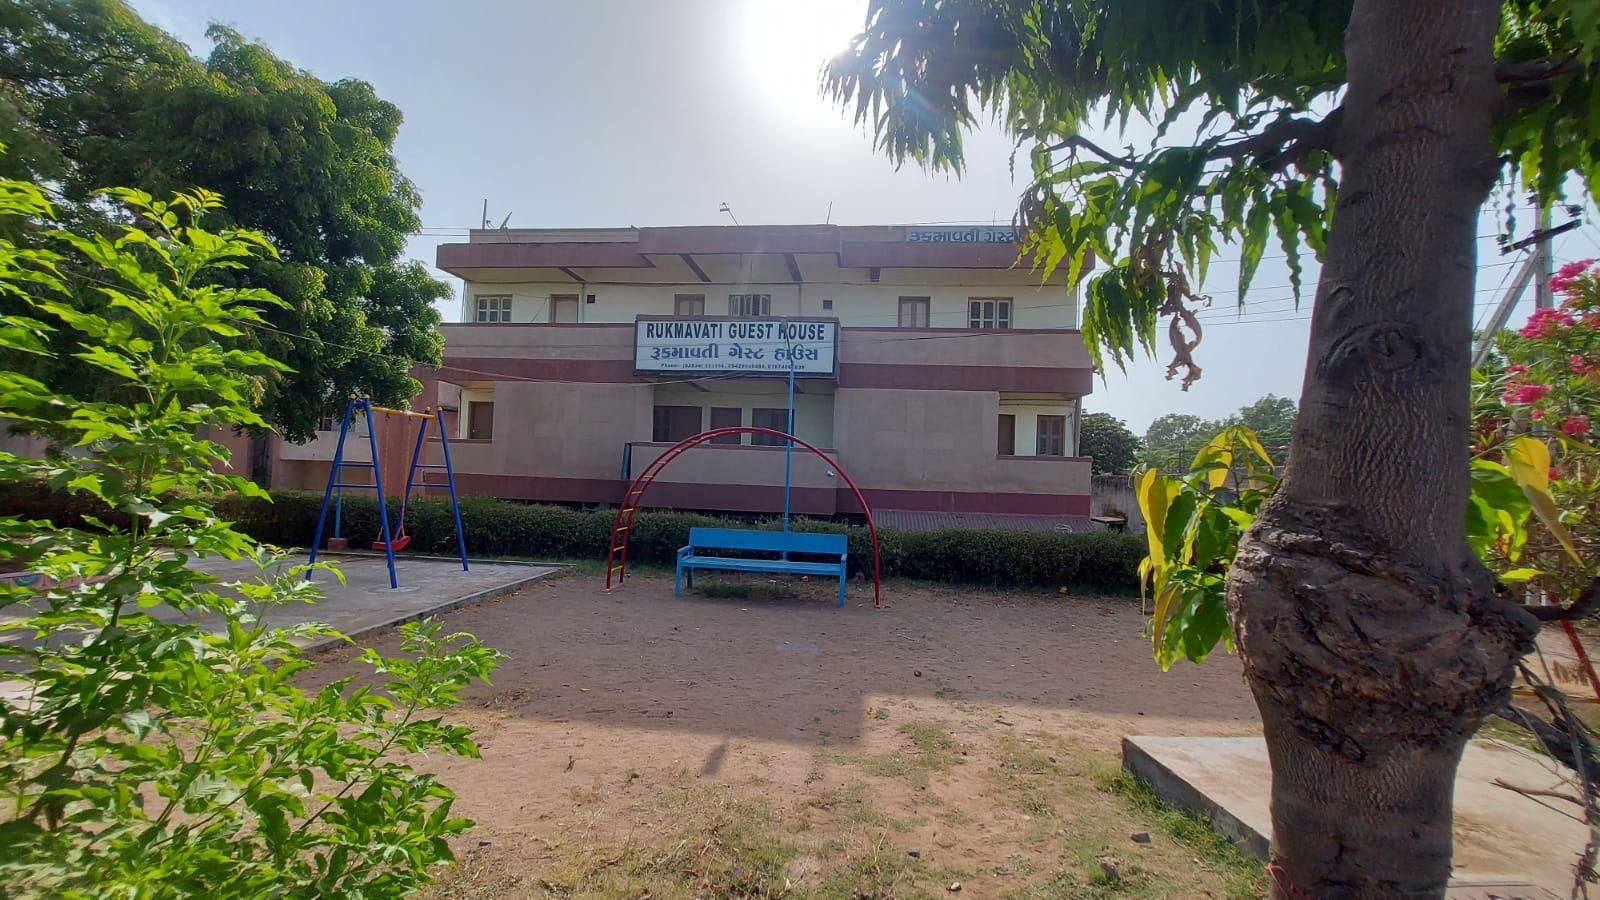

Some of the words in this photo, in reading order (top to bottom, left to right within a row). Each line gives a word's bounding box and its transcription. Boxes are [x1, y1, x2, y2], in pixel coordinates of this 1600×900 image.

[646, 322, 723, 339] RUKMAVATI
[729, 323, 774, 340] GUEST
[778, 323, 826, 341] HOUSE
